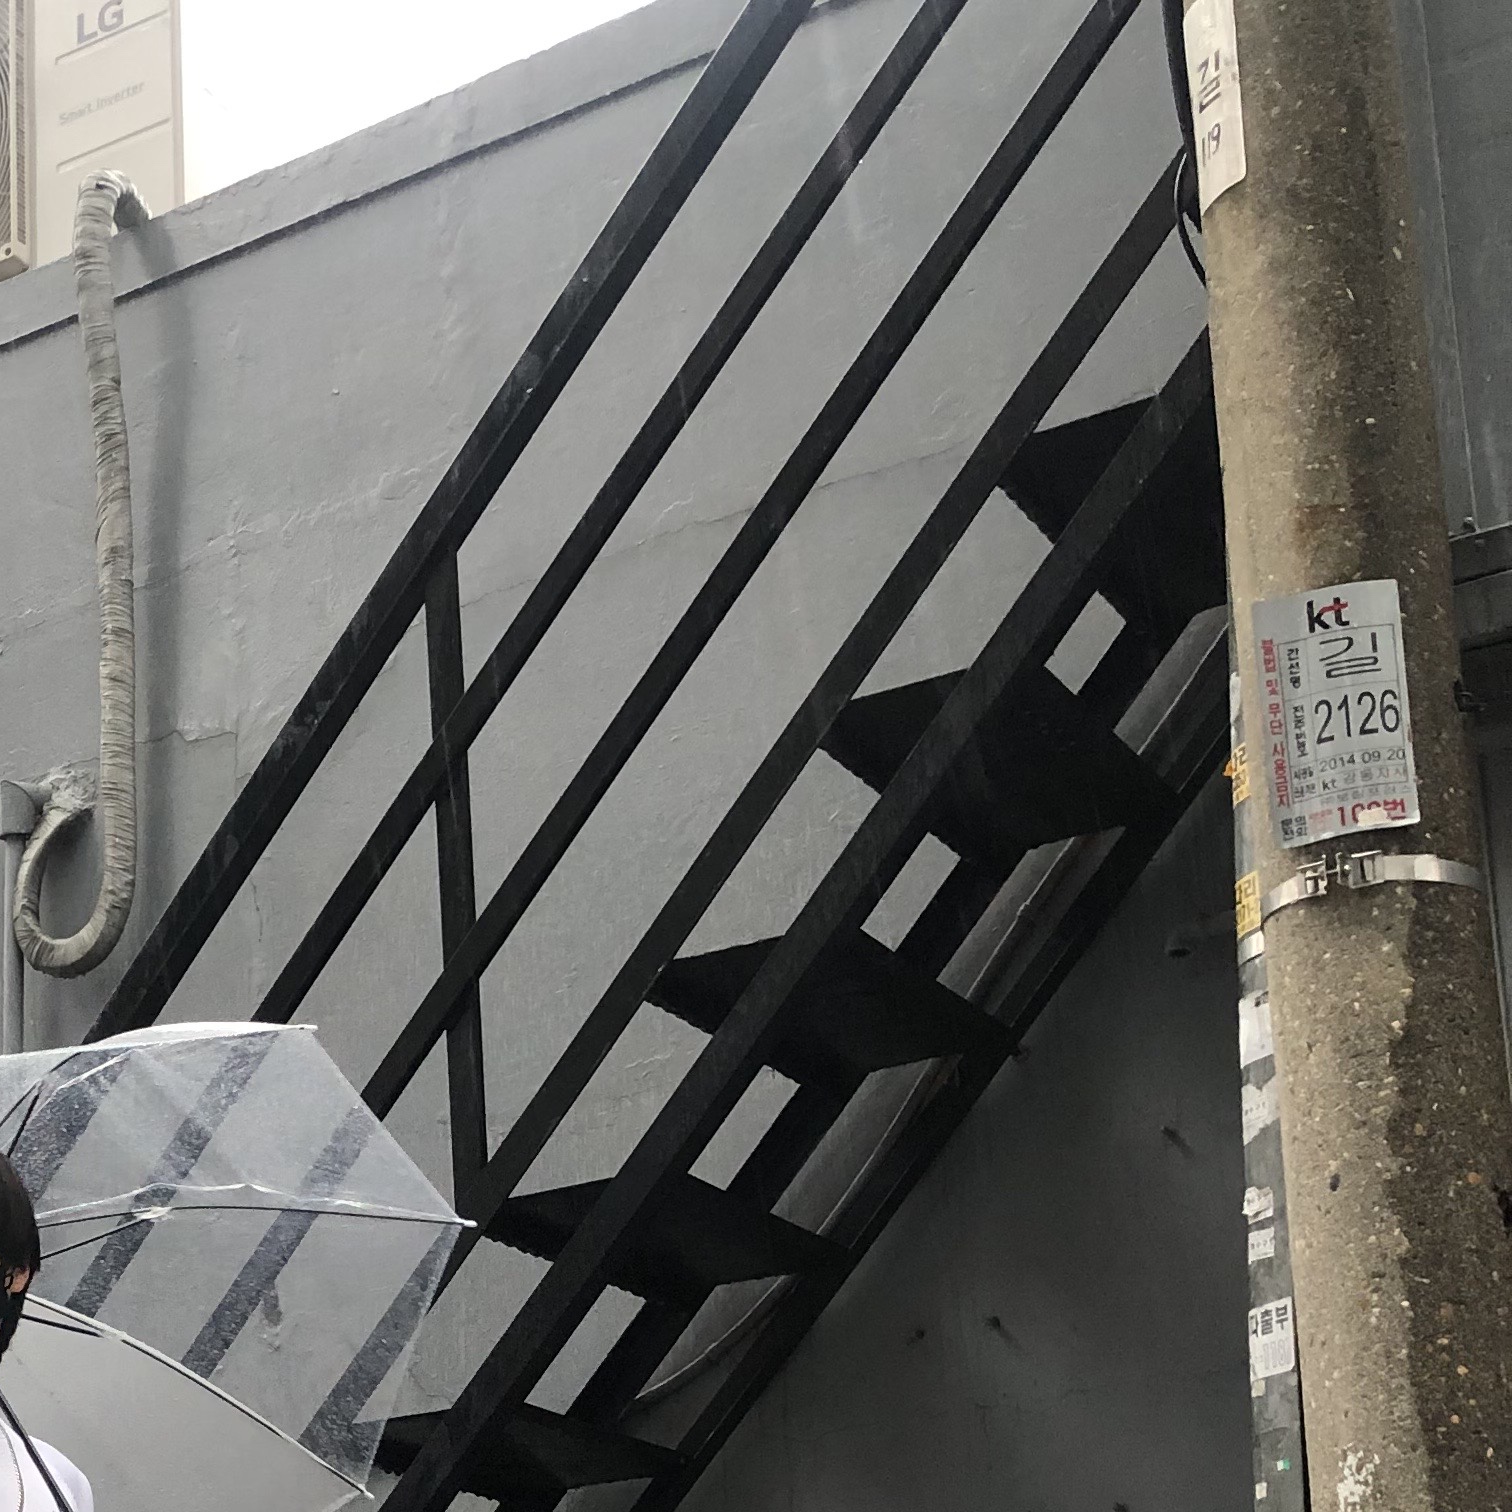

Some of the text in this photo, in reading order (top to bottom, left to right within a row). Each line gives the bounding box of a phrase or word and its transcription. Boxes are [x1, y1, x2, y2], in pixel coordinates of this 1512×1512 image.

[76, 0, 124, 45] LG
[1306, 597, 1350, 633] kt
[1319, 630, 1382, 679] 길
[1314, 689, 1400, 745] 2126
[1319, 753, 1355, 773] 2014
[1361, 750, 1381, 764] 09
[1388, 748, 1406, 761] 20
